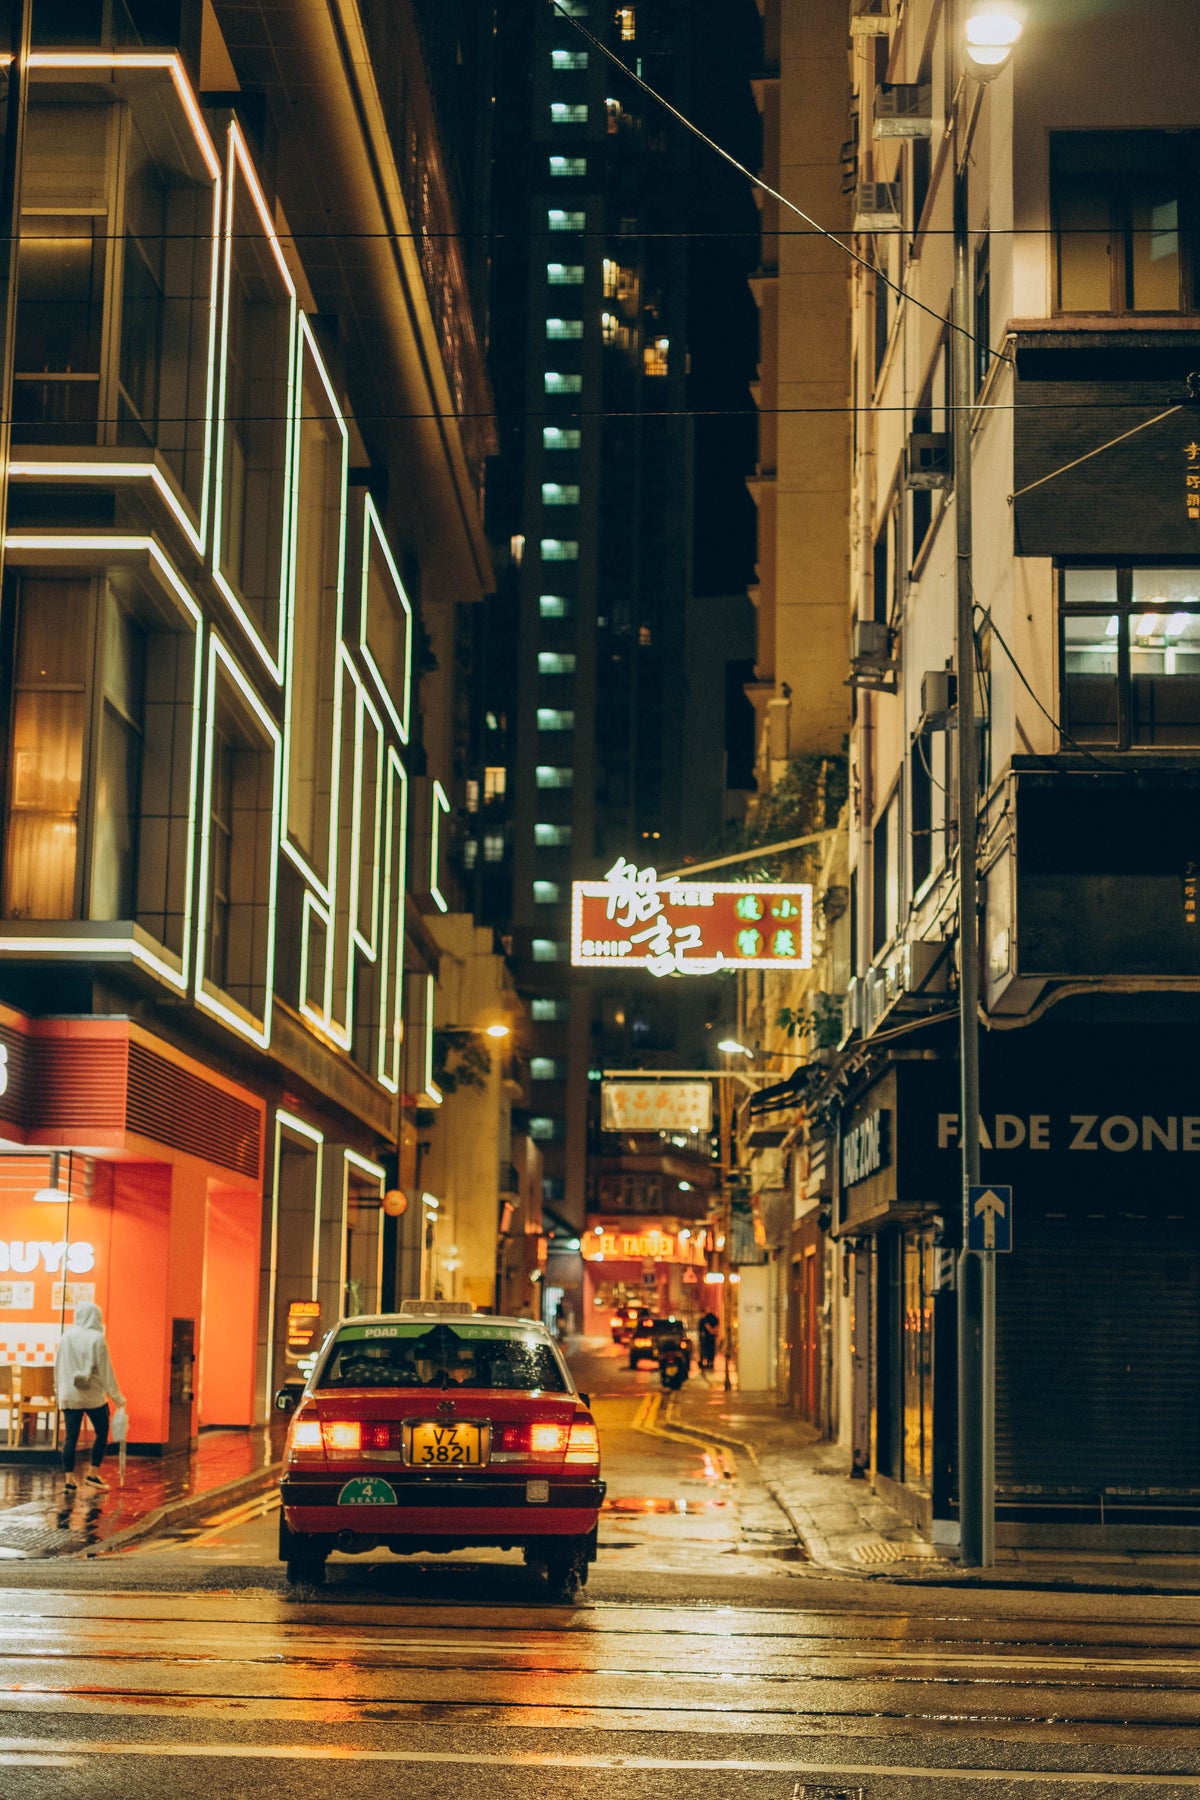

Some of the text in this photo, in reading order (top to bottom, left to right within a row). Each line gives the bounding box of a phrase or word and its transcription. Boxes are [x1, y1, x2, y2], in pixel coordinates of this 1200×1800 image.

[669, 891, 715, 907] KEE
[581, 940, 633, 957] SHIP
[1068, 1114, 1200, 1152] ZONE
[406, 1302, 468, 1314] TAXI
[365, 1328, 398, 1338] POAD
[433, 1429, 459, 1447] VZ
[422, 1446, 471, 1463] 3821
[361, 1485, 373, 1496] 4
[350, 1496, 386, 1504] SEATS
